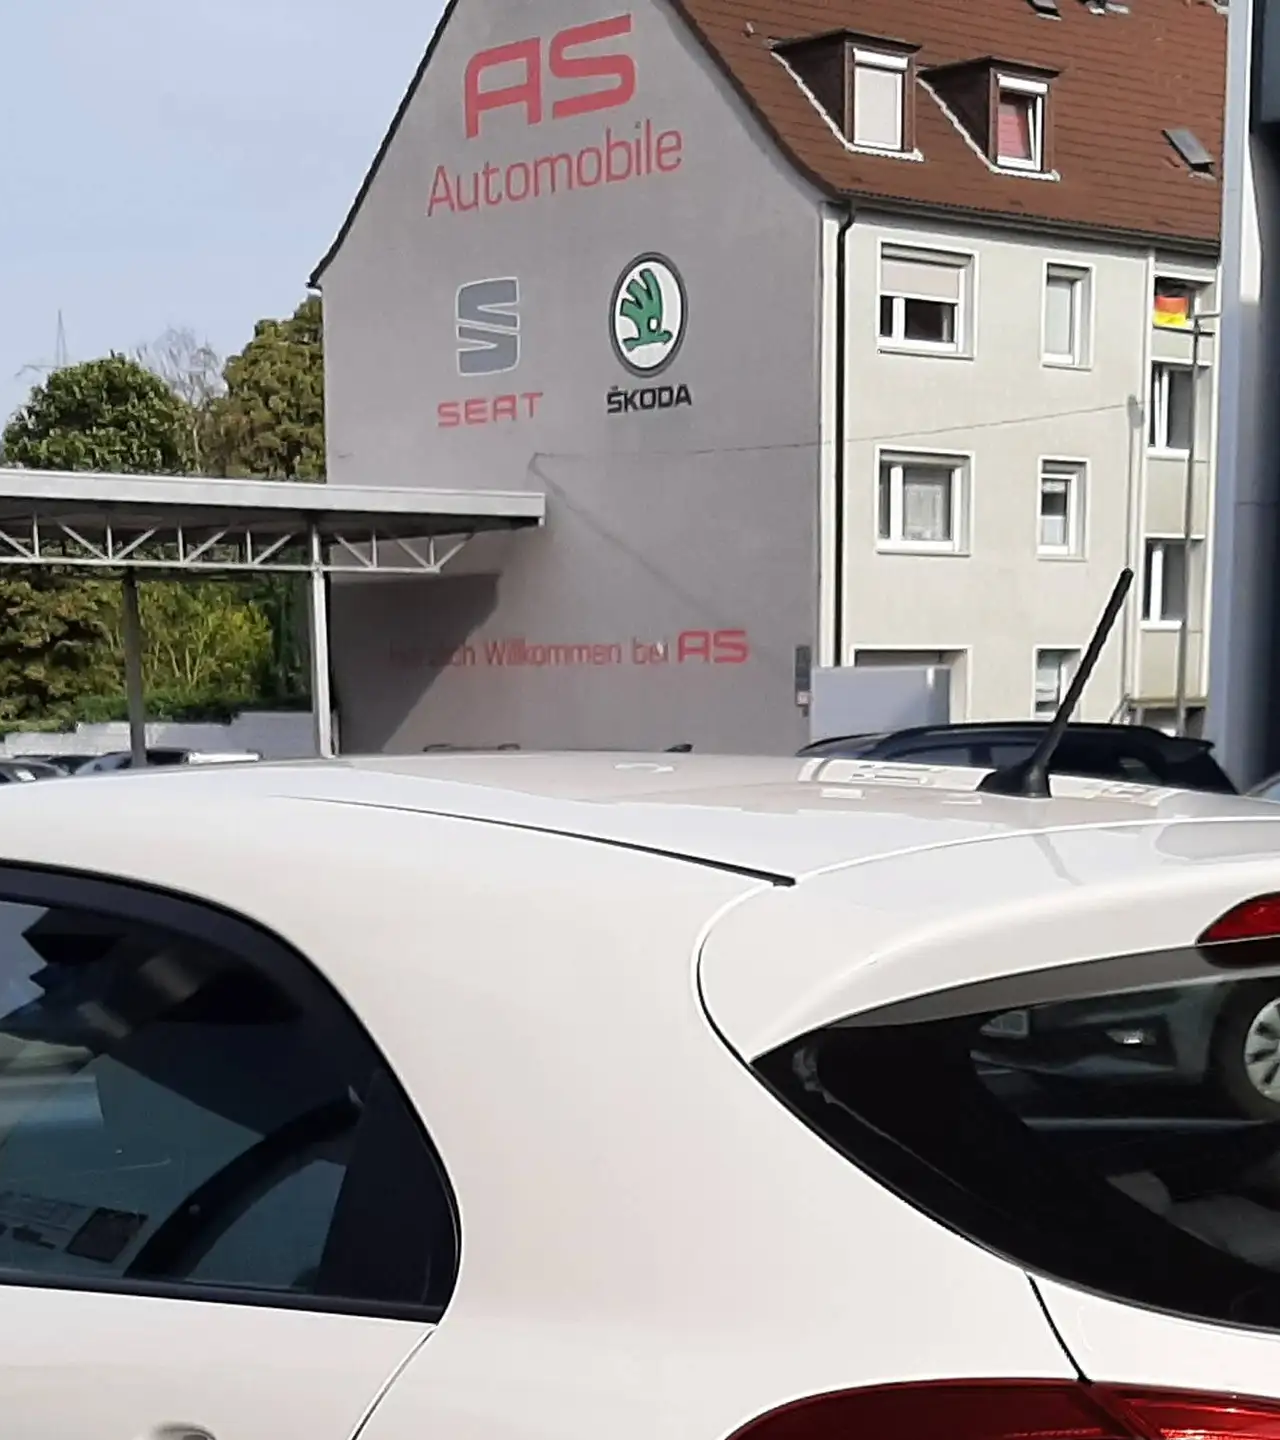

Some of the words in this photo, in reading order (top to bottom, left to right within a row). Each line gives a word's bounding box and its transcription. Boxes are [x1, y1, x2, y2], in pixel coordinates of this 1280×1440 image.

[464, 13, 637, 138] AS
[428, 118, 683, 217] Automobile
[437, 391, 543, 427] SEAT
[607, 383, 692, 414] ŠKODA
[483, 638, 622, 668] Willkommen
[677, 629, 749, 664] AS
